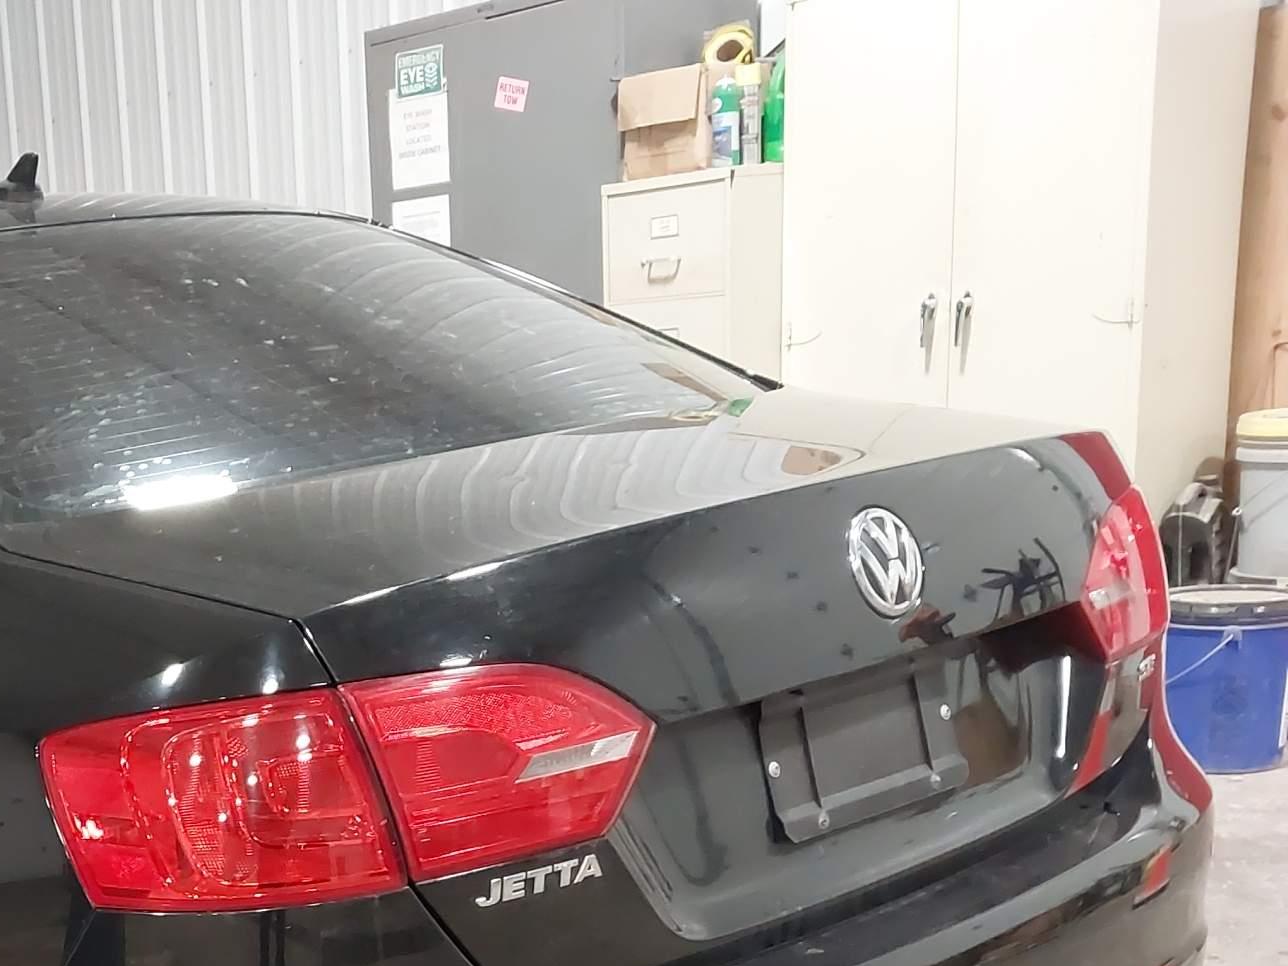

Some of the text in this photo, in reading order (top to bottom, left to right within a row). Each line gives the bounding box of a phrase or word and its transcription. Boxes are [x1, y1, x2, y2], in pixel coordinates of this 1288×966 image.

[400, 65, 424, 86] EYE
[400, 82, 425, 95] WASH
[499, 82, 526, 96] RETURN
[504, 94, 518, 105] TOW
[850, 508, 922, 616] VW
[475, 853, 603, 908] JETTA
